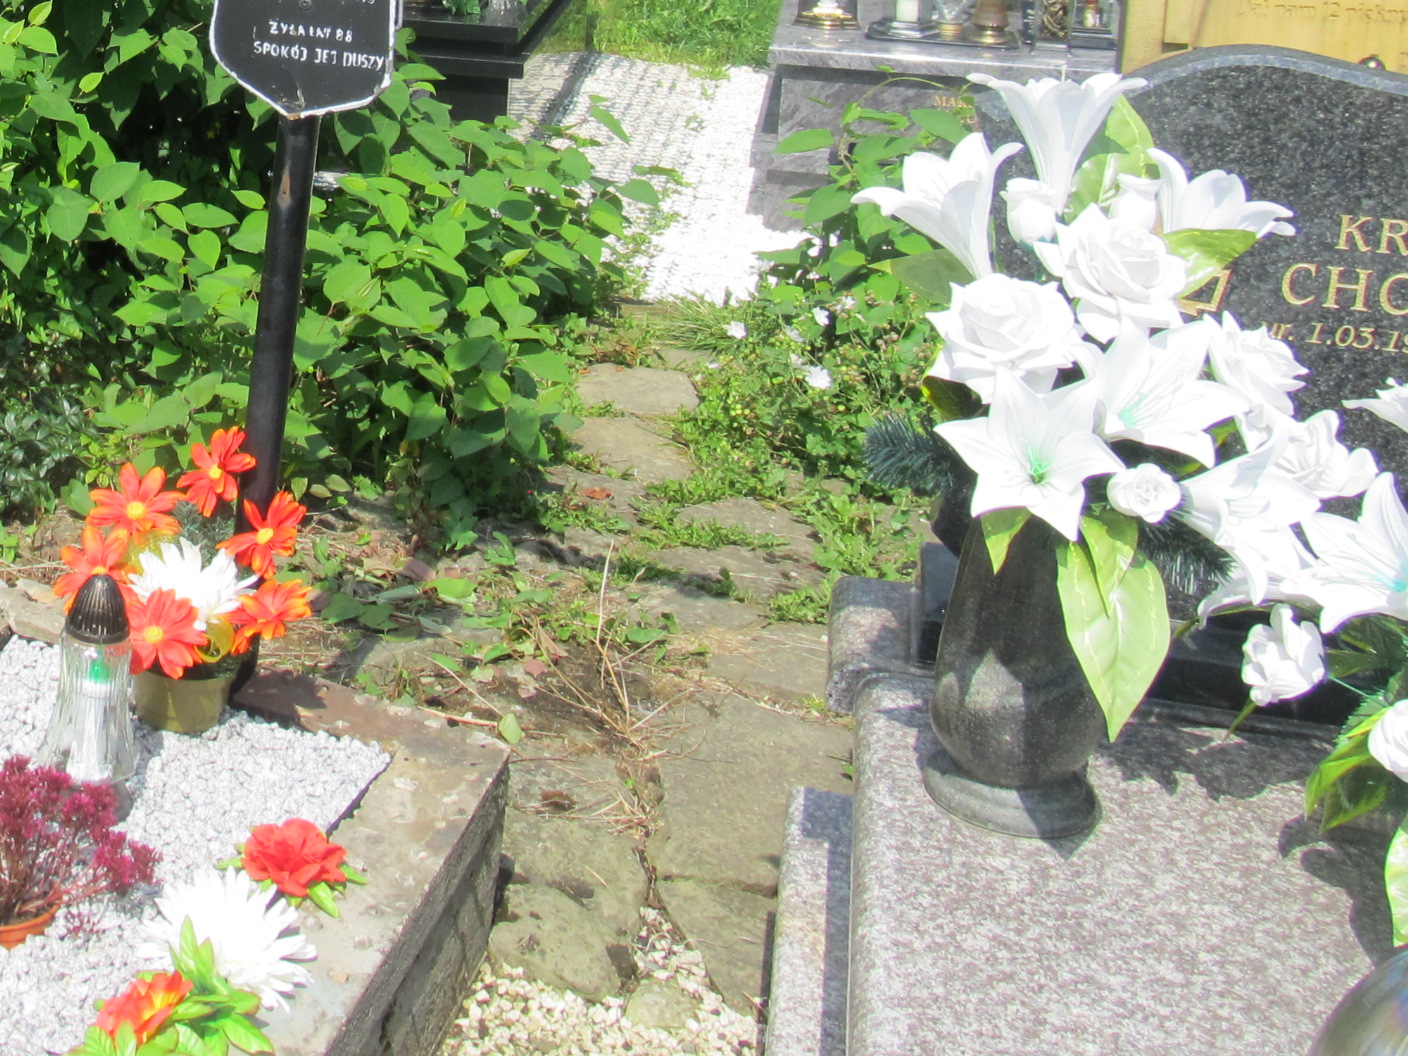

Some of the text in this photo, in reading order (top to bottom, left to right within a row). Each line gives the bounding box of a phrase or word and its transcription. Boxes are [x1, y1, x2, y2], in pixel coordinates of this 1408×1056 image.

[335, 28, 353, 43] 88
[253, 40, 385, 71] SPOKÓJ JEJ DUSZY
